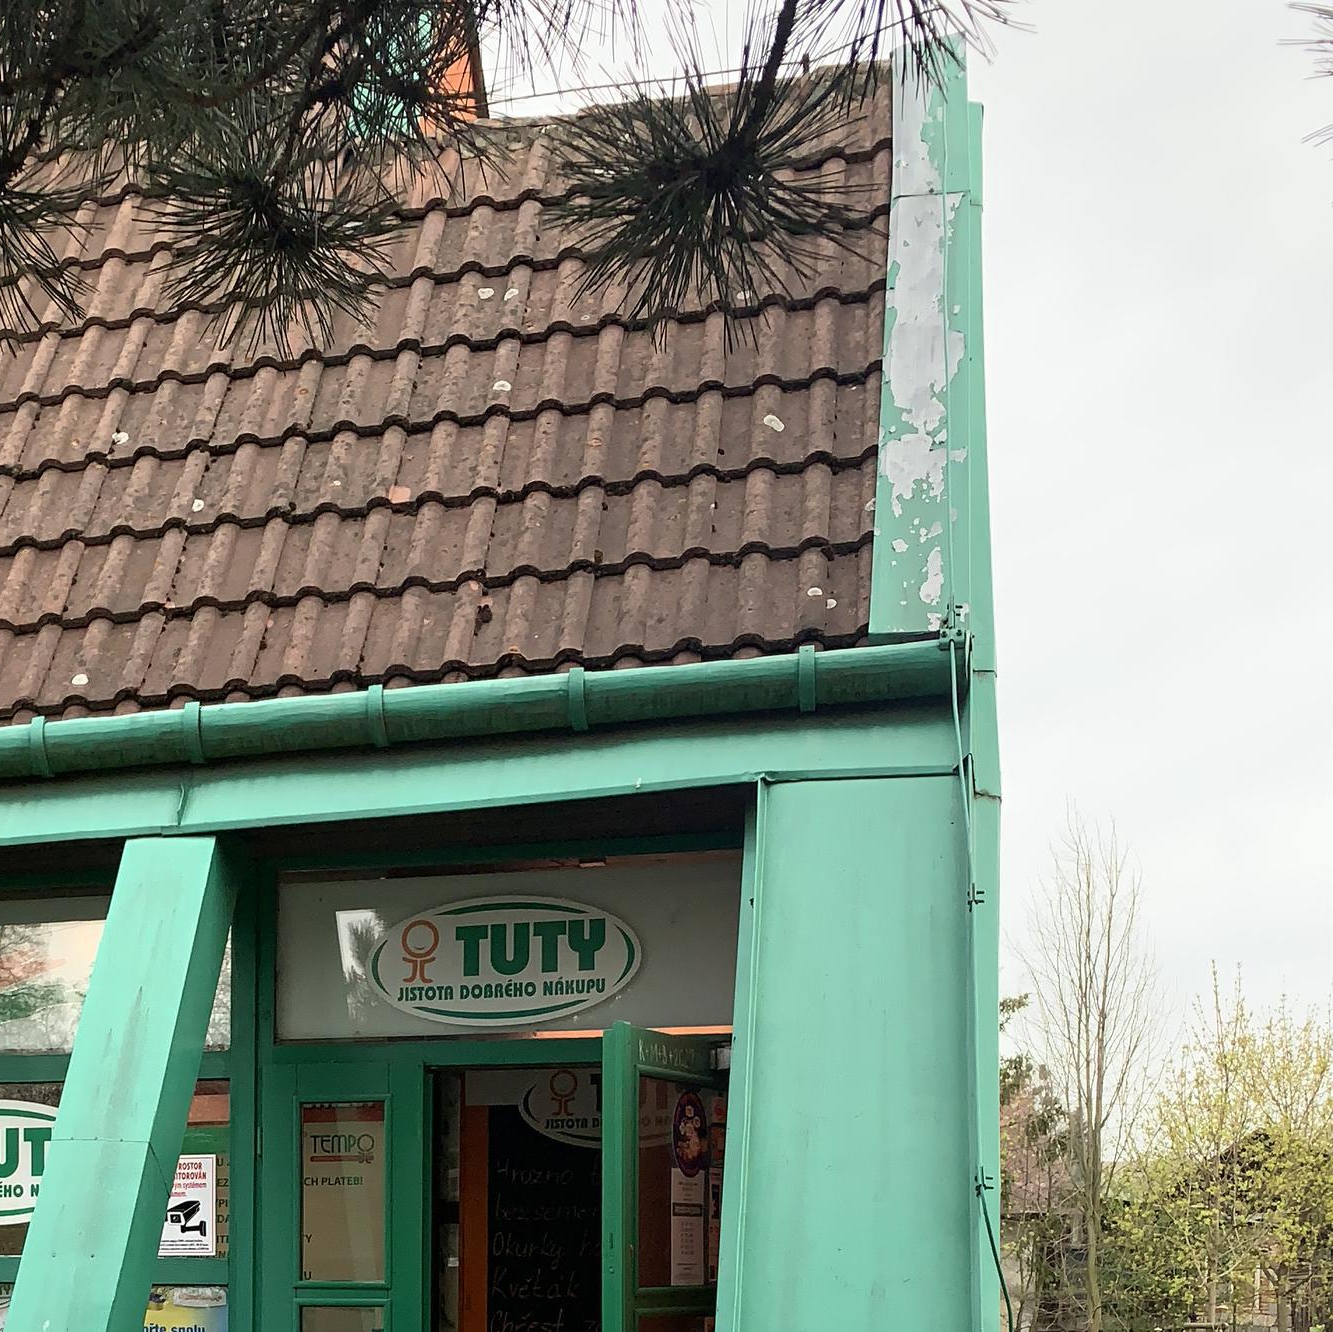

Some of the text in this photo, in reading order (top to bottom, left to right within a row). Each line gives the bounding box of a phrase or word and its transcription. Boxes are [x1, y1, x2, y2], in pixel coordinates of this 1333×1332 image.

[455, 918, 606, 977] TUTY
[397, 976, 606, 1002] JISTOTA DOBRÉHO NÁKUPU
[310, 1134, 375, 1154] TEMPO
[178, 1162, 203, 1170] ROSTOR
[175, 1171, 207, 1180] ITOROVÁN
[321, 1176, 364, 1186] PLATEB!
